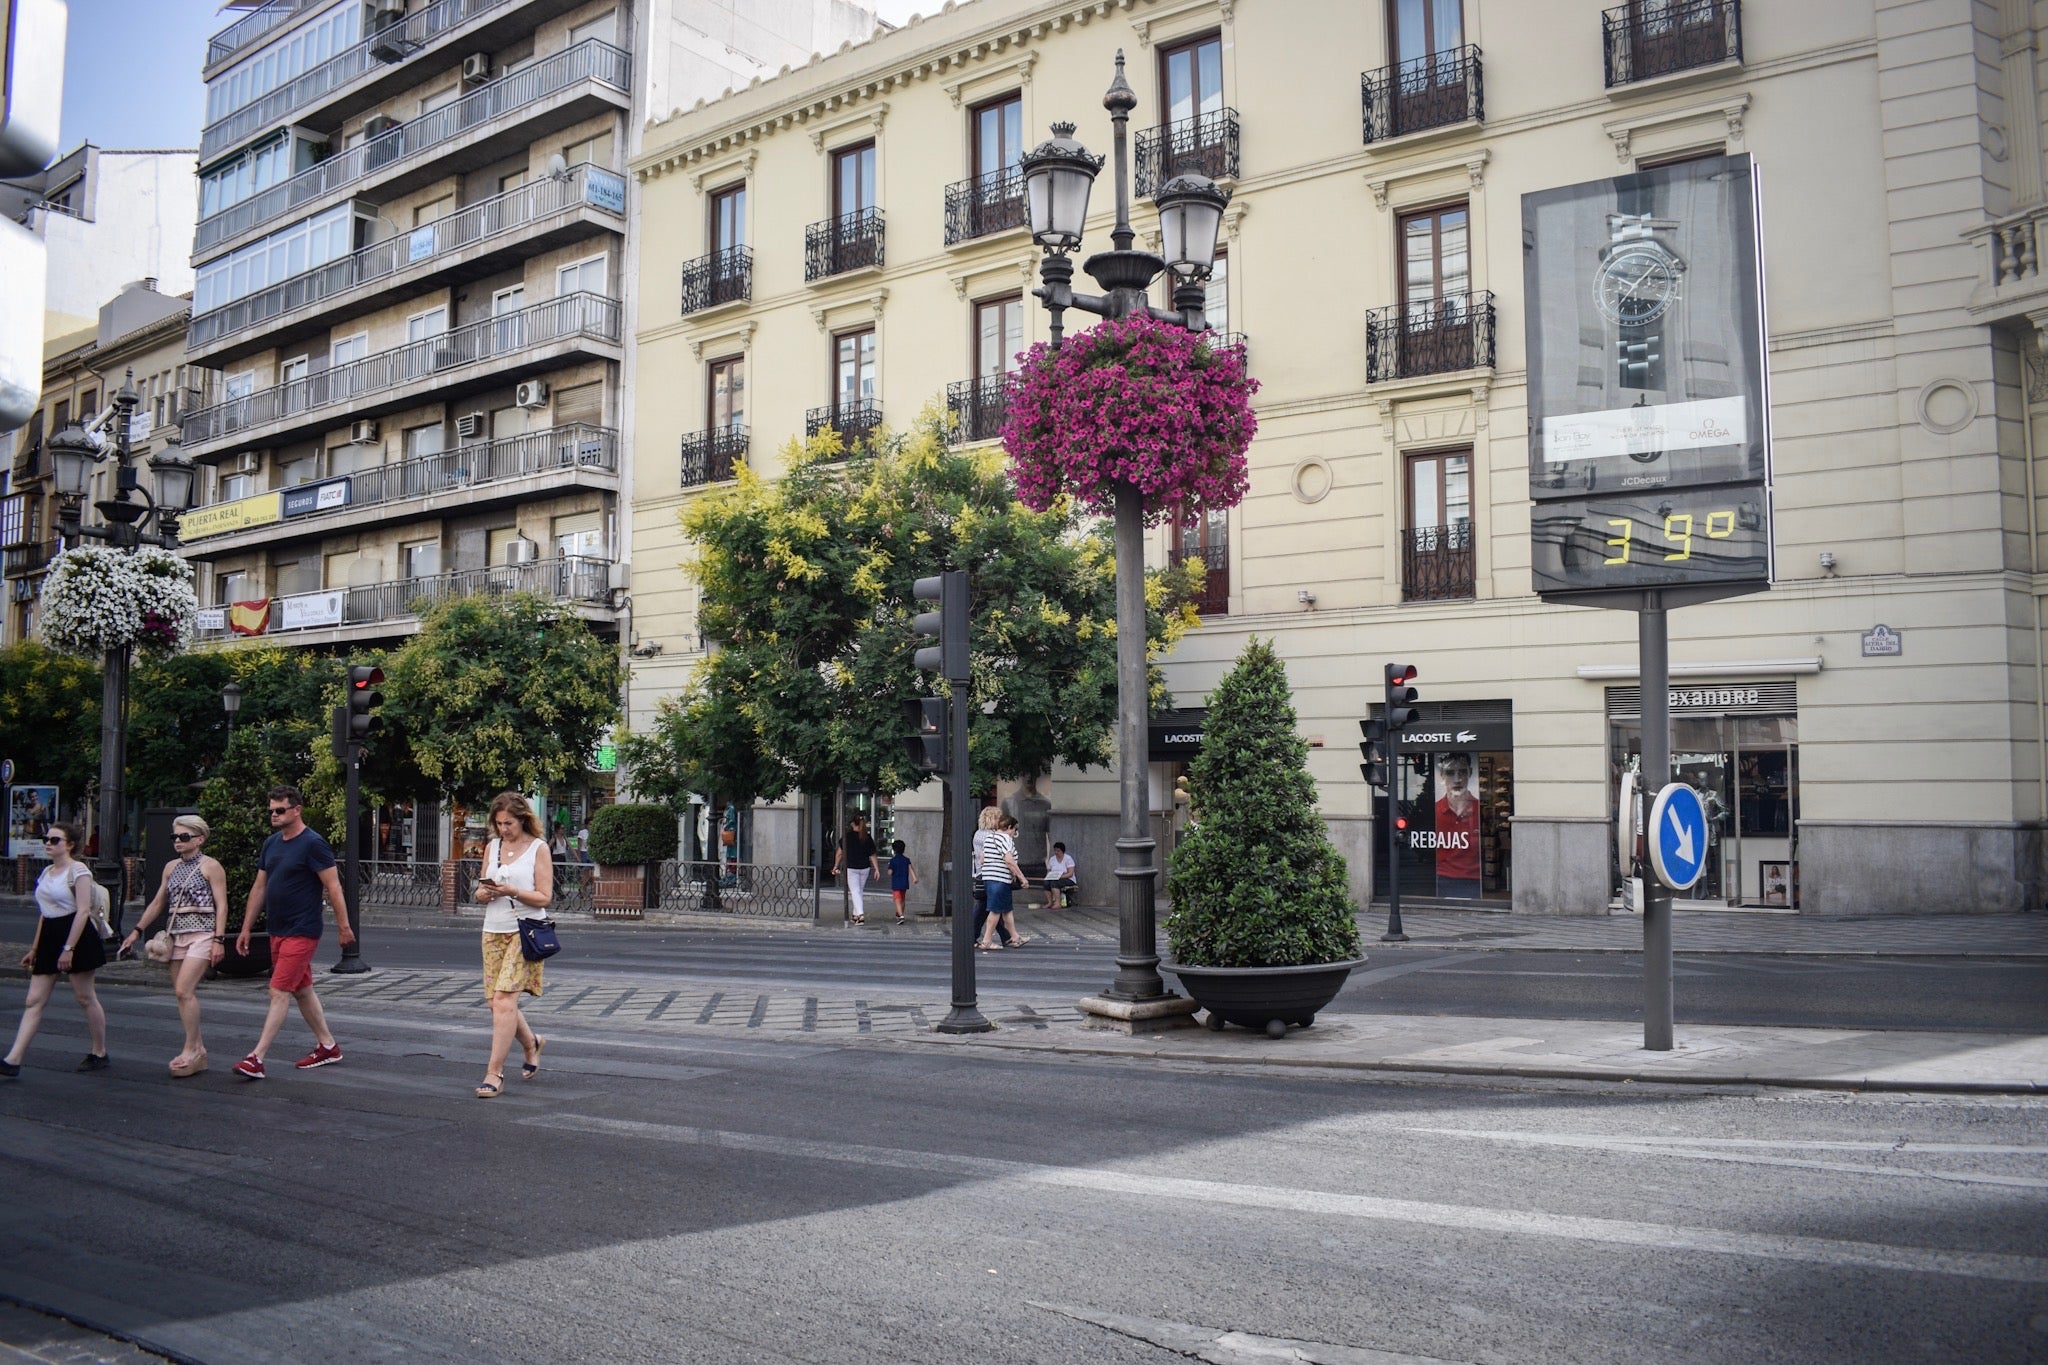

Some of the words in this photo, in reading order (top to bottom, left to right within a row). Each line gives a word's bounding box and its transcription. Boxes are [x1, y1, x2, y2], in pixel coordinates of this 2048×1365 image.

[1689, 428, 1730, 440] OMEGA
[1621, 476, 1667, 486] JCDecaux
[288, 497, 313, 509] SEGUROS
[188, 513, 218, 528] PUERTA
[219, 507, 239, 520] REAL
[1402, 733, 1452, 743] LACOSTE
[1411, 831, 1470, 849] REBAJAS
